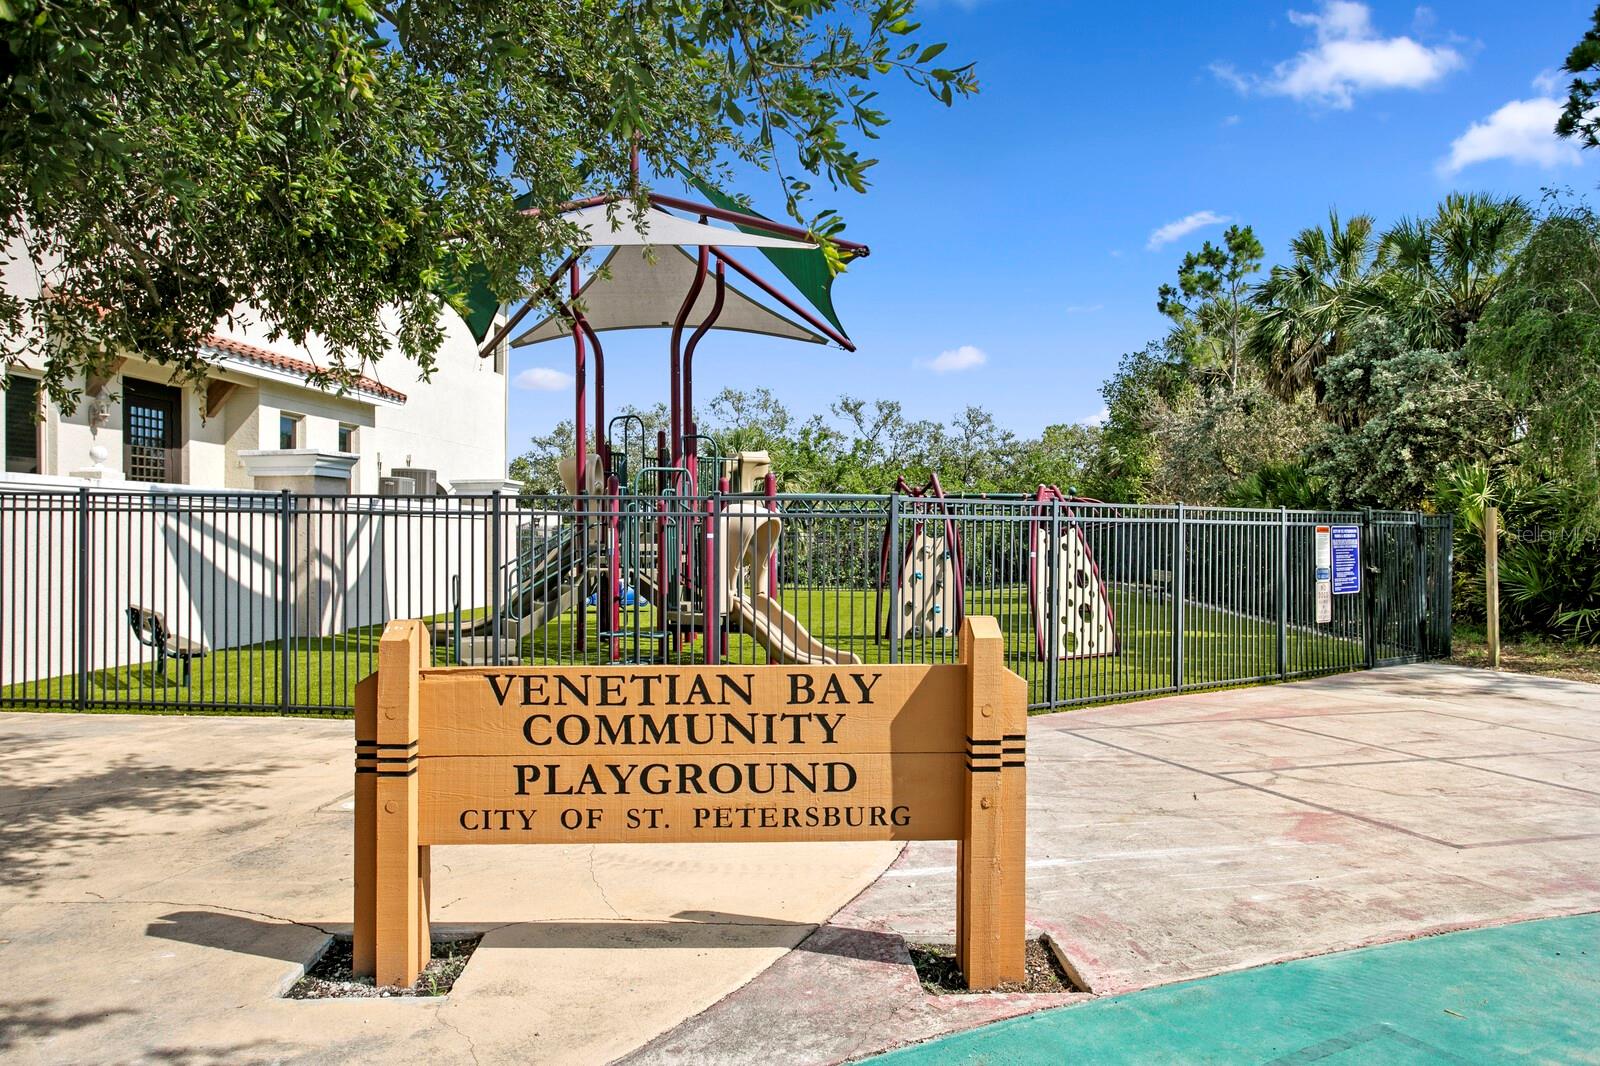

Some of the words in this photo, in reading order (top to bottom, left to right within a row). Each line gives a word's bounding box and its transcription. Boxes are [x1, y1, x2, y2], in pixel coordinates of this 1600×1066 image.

[484, 674, 754, 706] VENETIAN
[787, 673, 881, 704] BAY
[523, 713, 846, 745] COMMUNITY
[513, 762, 856, 795] PLAYGROUND
[460, 809, 536, 830] CITY
[561, 809, 603, 830] OF
[627, 808, 669, 829] ST.
[694, 806, 911, 829] PETERSBURG
